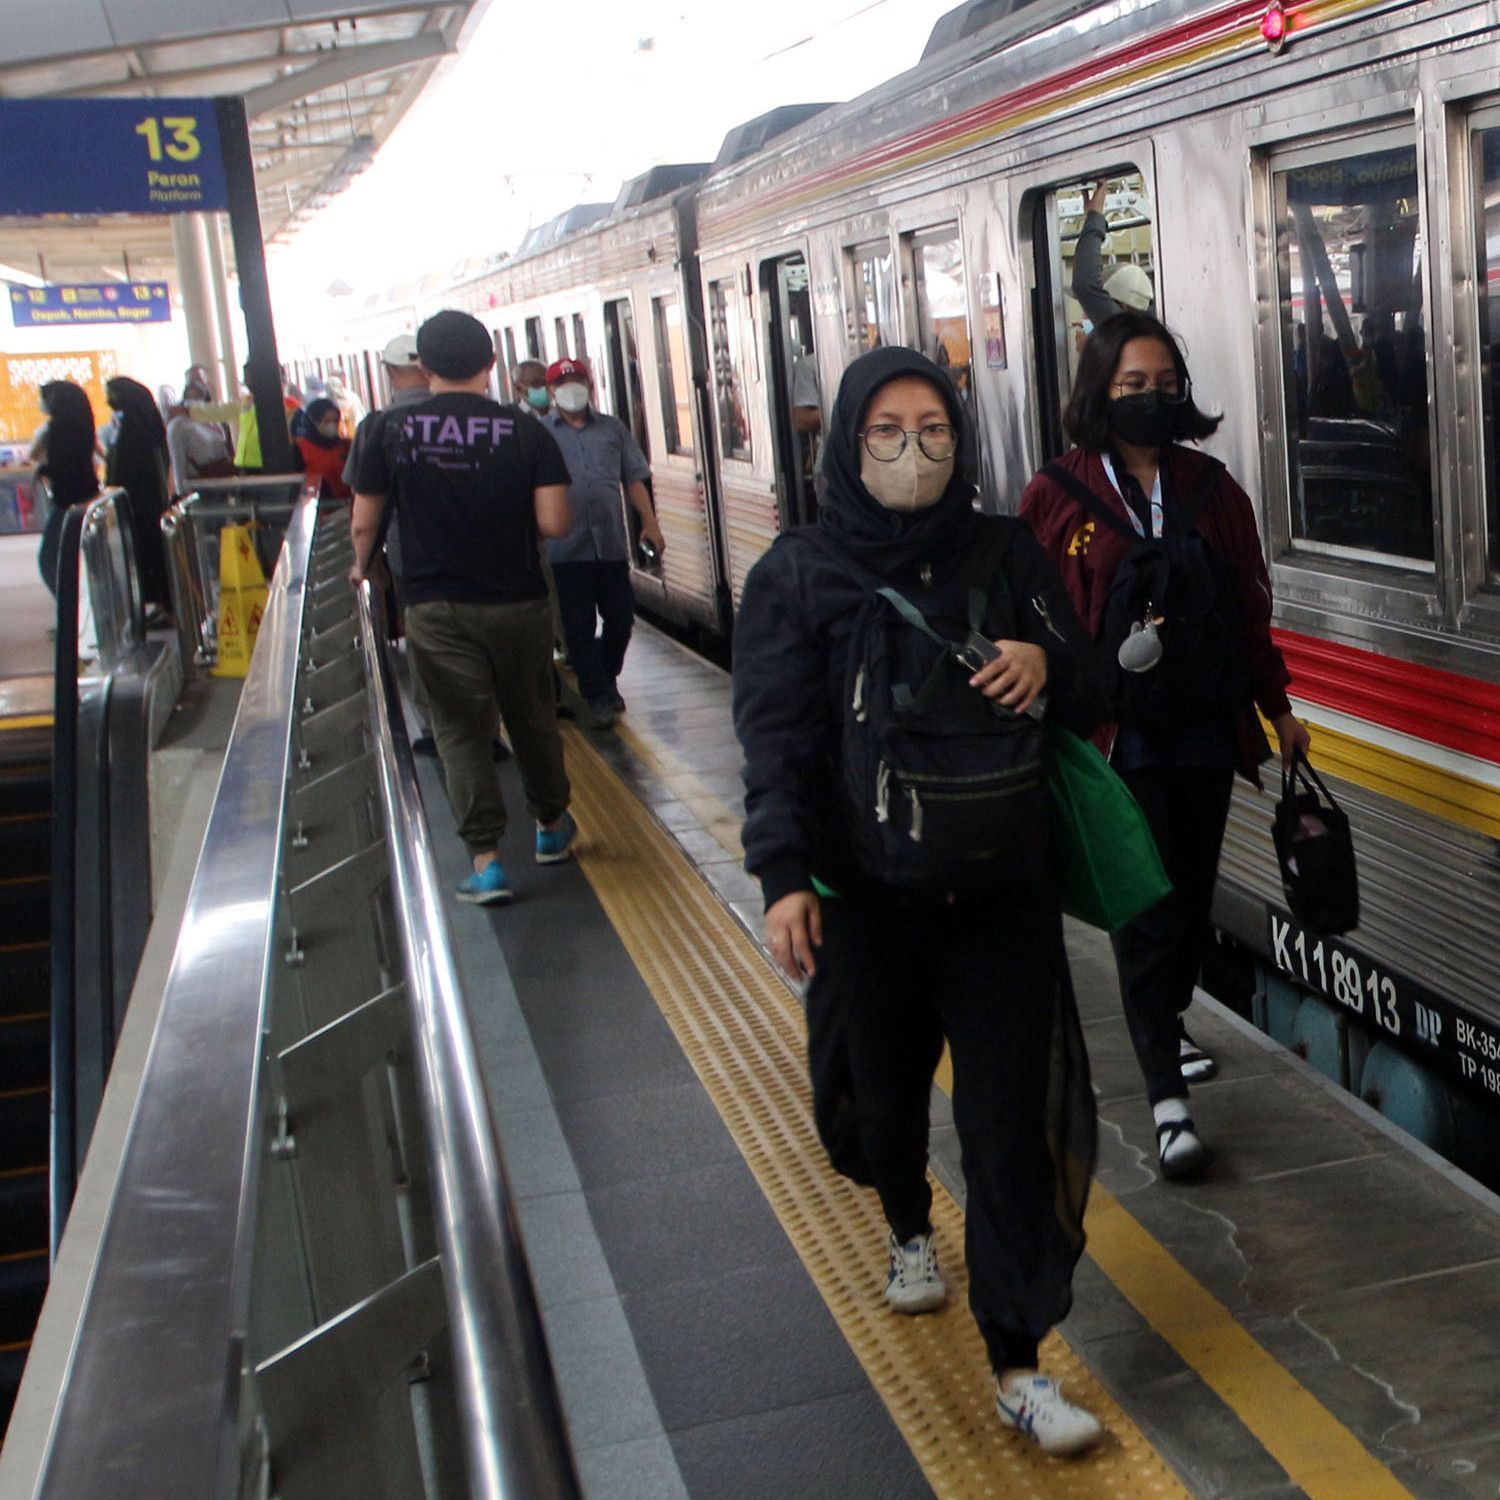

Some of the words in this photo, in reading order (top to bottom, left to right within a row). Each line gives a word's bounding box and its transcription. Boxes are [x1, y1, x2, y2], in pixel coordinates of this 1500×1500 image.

[135, 116, 202, 162] 13
[147, 169, 201, 188] Peron
[149, 188, 204, 201] Platform
[1271, 915, 1401, 1037] K118913
[1458, 1051, 1477, 1079] TP
